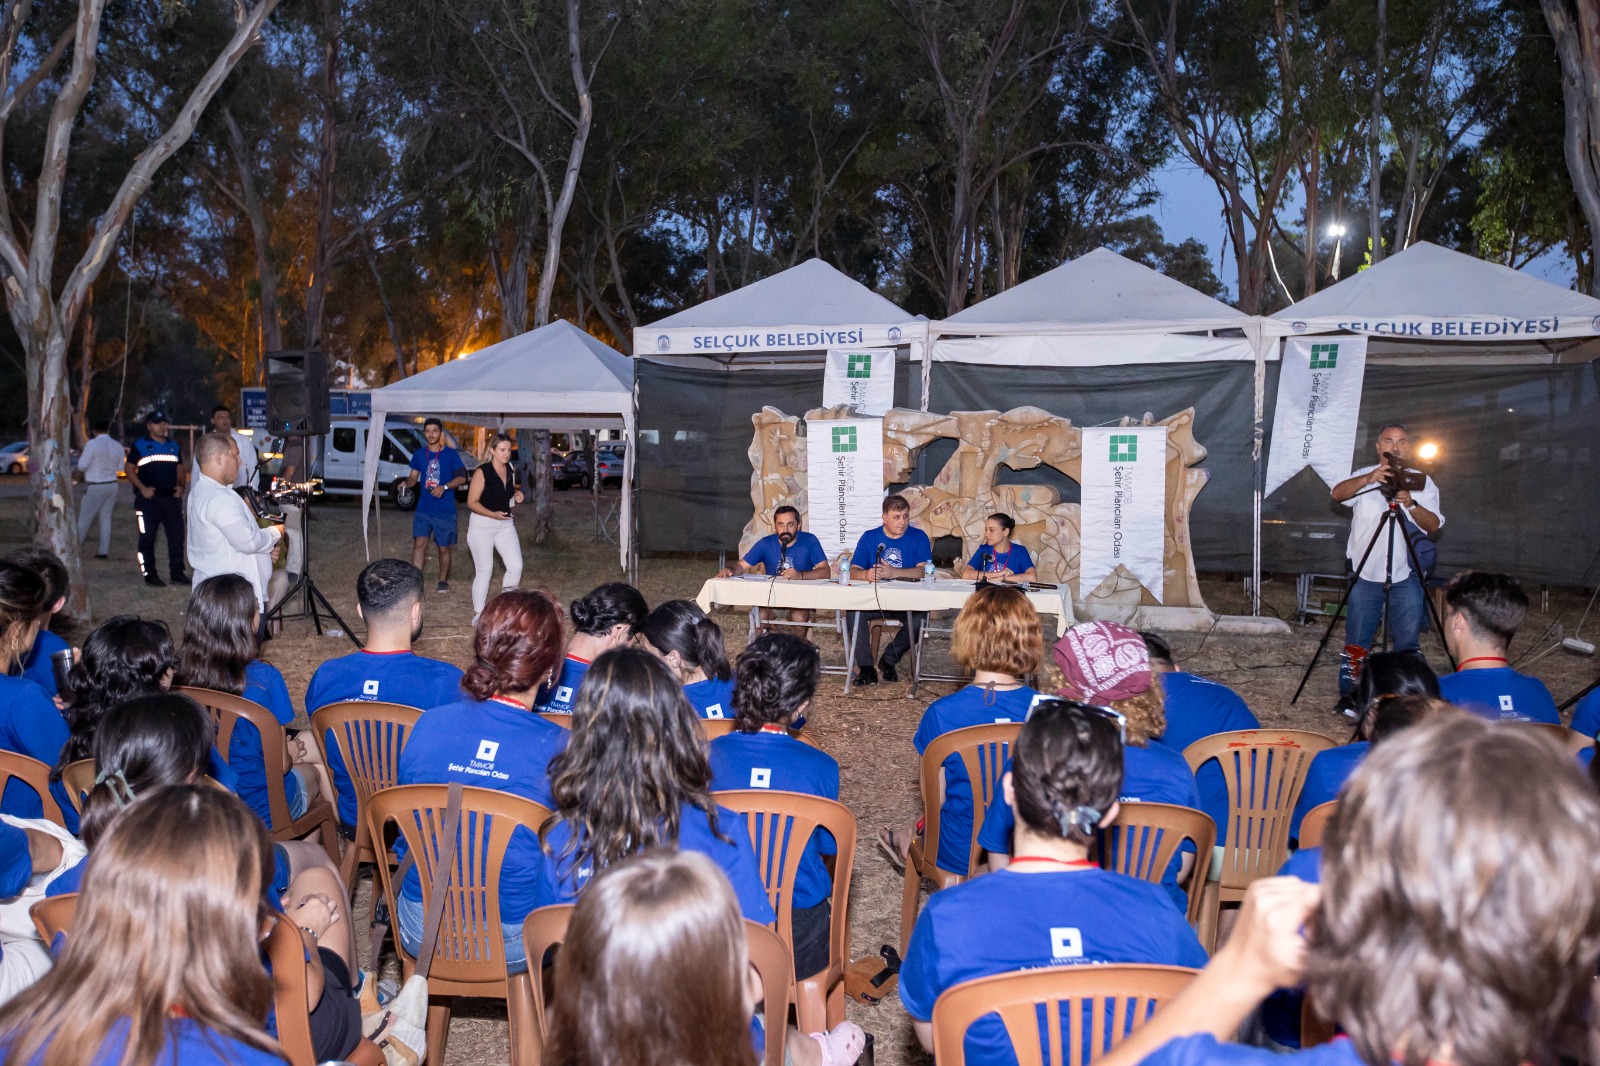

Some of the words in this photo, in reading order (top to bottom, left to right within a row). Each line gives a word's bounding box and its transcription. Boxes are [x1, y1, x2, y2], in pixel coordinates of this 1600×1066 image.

[693, 334, 760, 351] SELÇUK
[766, 327, 863, 347] BELEDİYESİ
[1431, 317, 1559, 336] BELEDİYESİ
[850, 381, 859, 401] Şehir
[1311, 372, 1322, 394] Şehir
[1318, 372, 1332, 408] TMMOB
[1302, 433, 1314, 460] Odası
[835, 455, 846, 478] Şehir
[846, 456, 855, 492] TMMOB
[1113, 466, 1123, 488] Şehir
[1123, 466, 1133, 504] TMMOB
[838, 518, 848, 544] Odası
[1113, 532, 1122, 559] Odası
